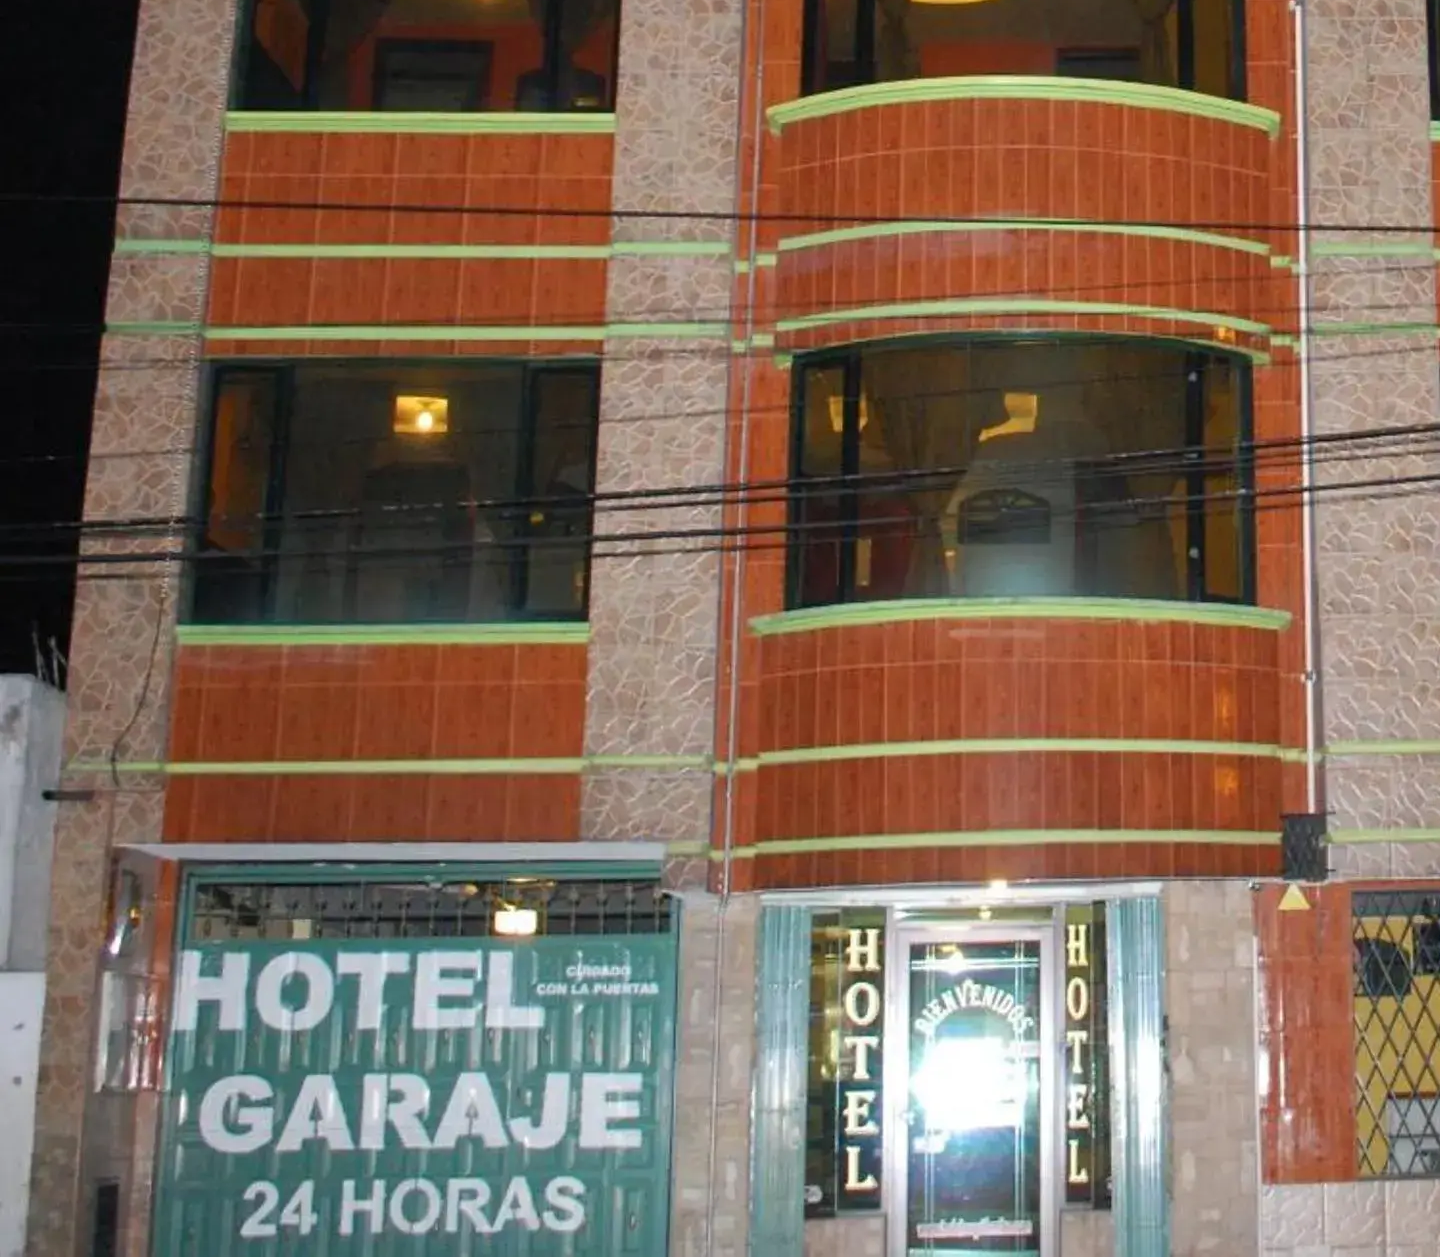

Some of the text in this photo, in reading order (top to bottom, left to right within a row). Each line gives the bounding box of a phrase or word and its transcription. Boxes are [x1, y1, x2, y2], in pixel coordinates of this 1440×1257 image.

[172, 949, 546, 1030] HOTEL
[536, 982, 660, 995] CON LA PUERTAS
[914, 978, 1035, 1035] BIENVENIDOS
[844, 928, 882, 1191] HOTEL
[1066, 924, 1089, 1184] HOTEL
[200, 1071, 644, 1153] GARAJE
[240, 1175, 588, 1238] 24 HORAS
